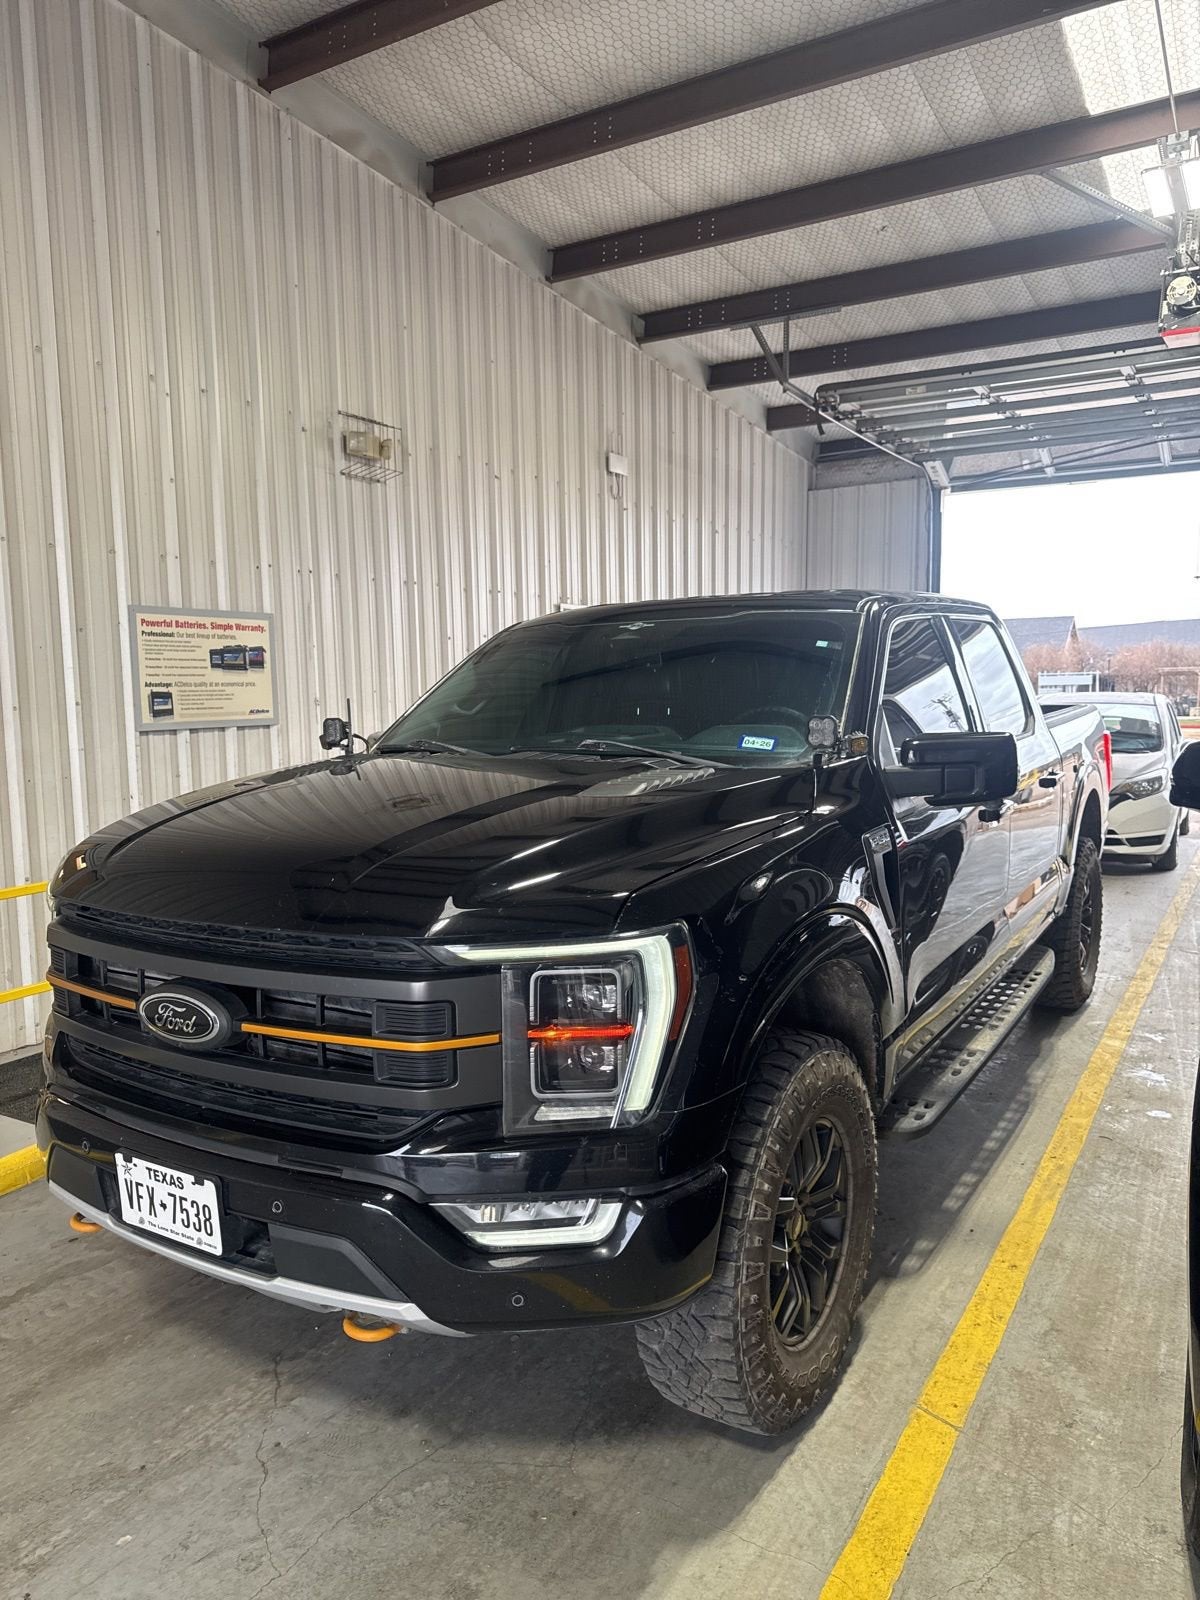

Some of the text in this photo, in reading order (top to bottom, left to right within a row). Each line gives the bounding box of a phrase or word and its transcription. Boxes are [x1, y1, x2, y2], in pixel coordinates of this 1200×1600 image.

[140, 618, 267, 634] Powerful Batteries. Simple Warranty.
[141, 630, 175, 638] Professional:
[145, 681, 173, 689] Advantage:
[194, 681, 208, 689] quality
[155, 1002, 197, 1033] Ford
[145, 1166, 185, 1190] TEXAS
[157, 1224, 169, 1233] Lone
[170, 1228, 181, 1236] Star
[181, 1232, 195, 1241] State
